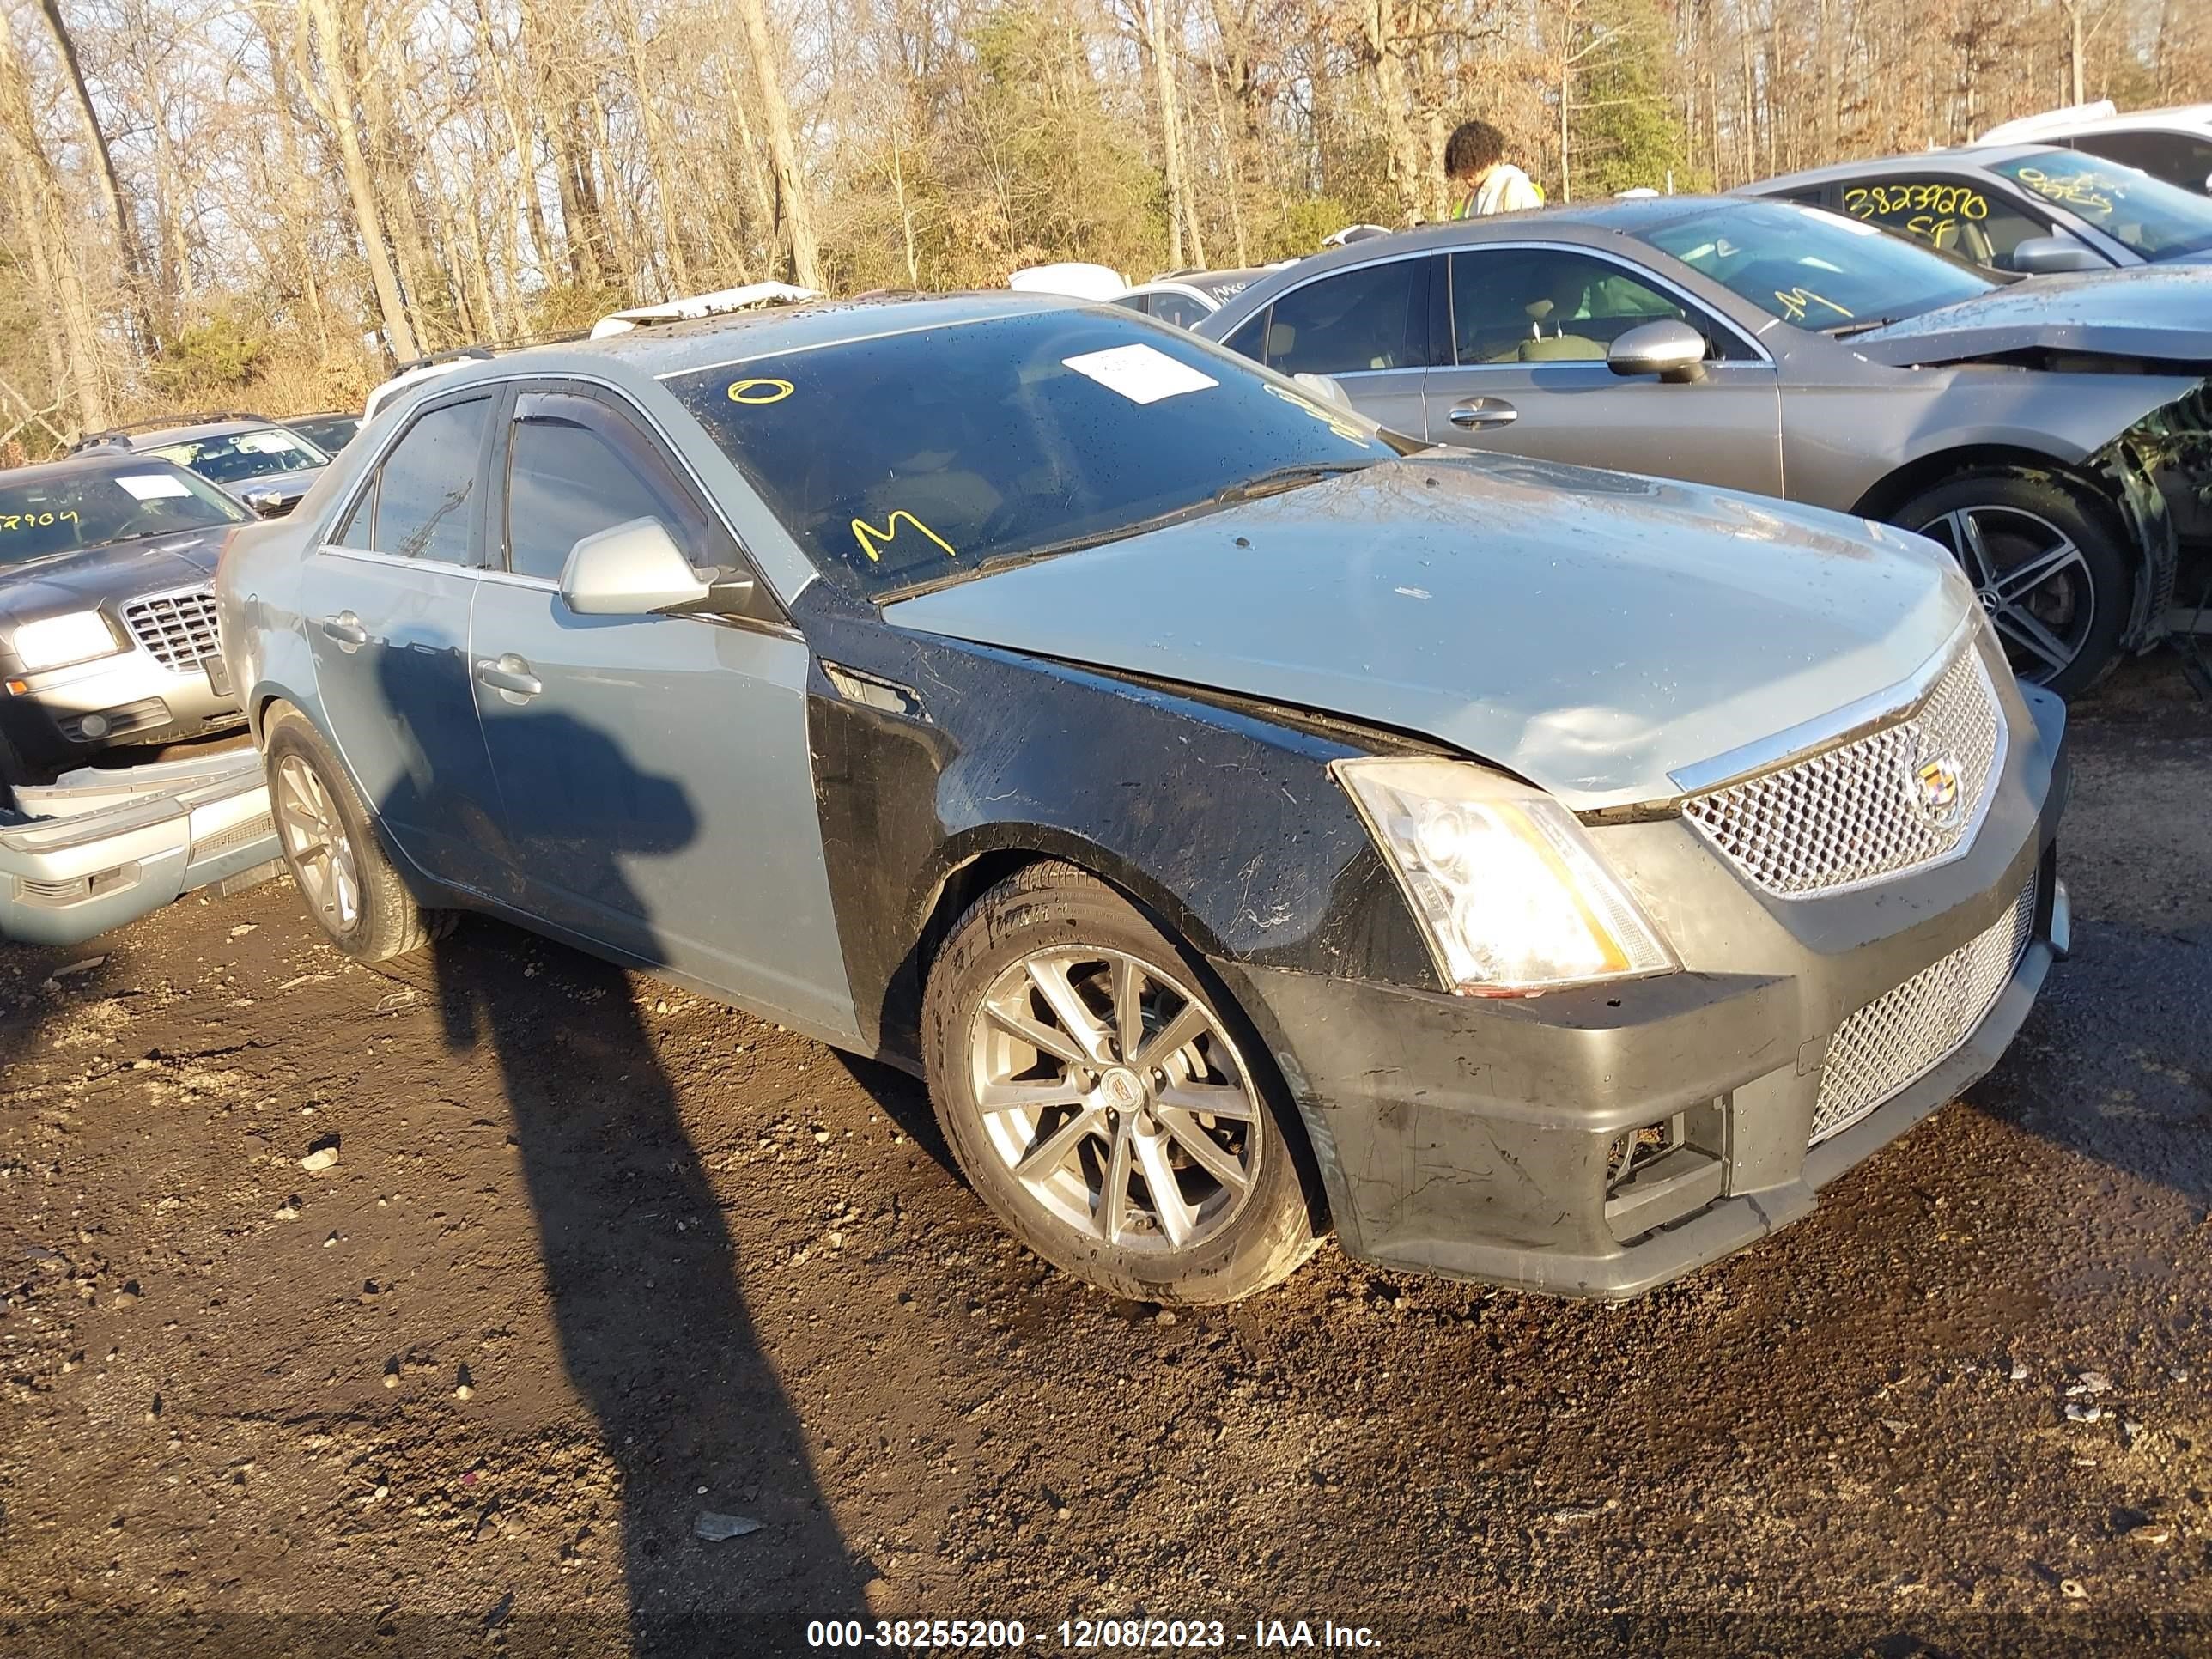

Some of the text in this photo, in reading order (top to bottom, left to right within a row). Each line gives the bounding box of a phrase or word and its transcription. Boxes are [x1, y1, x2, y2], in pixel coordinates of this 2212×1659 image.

[1845, 184, 1988, 221] 38239270
[0, 511, 79, 532] 2904
[851, 510, 956, 562] M
